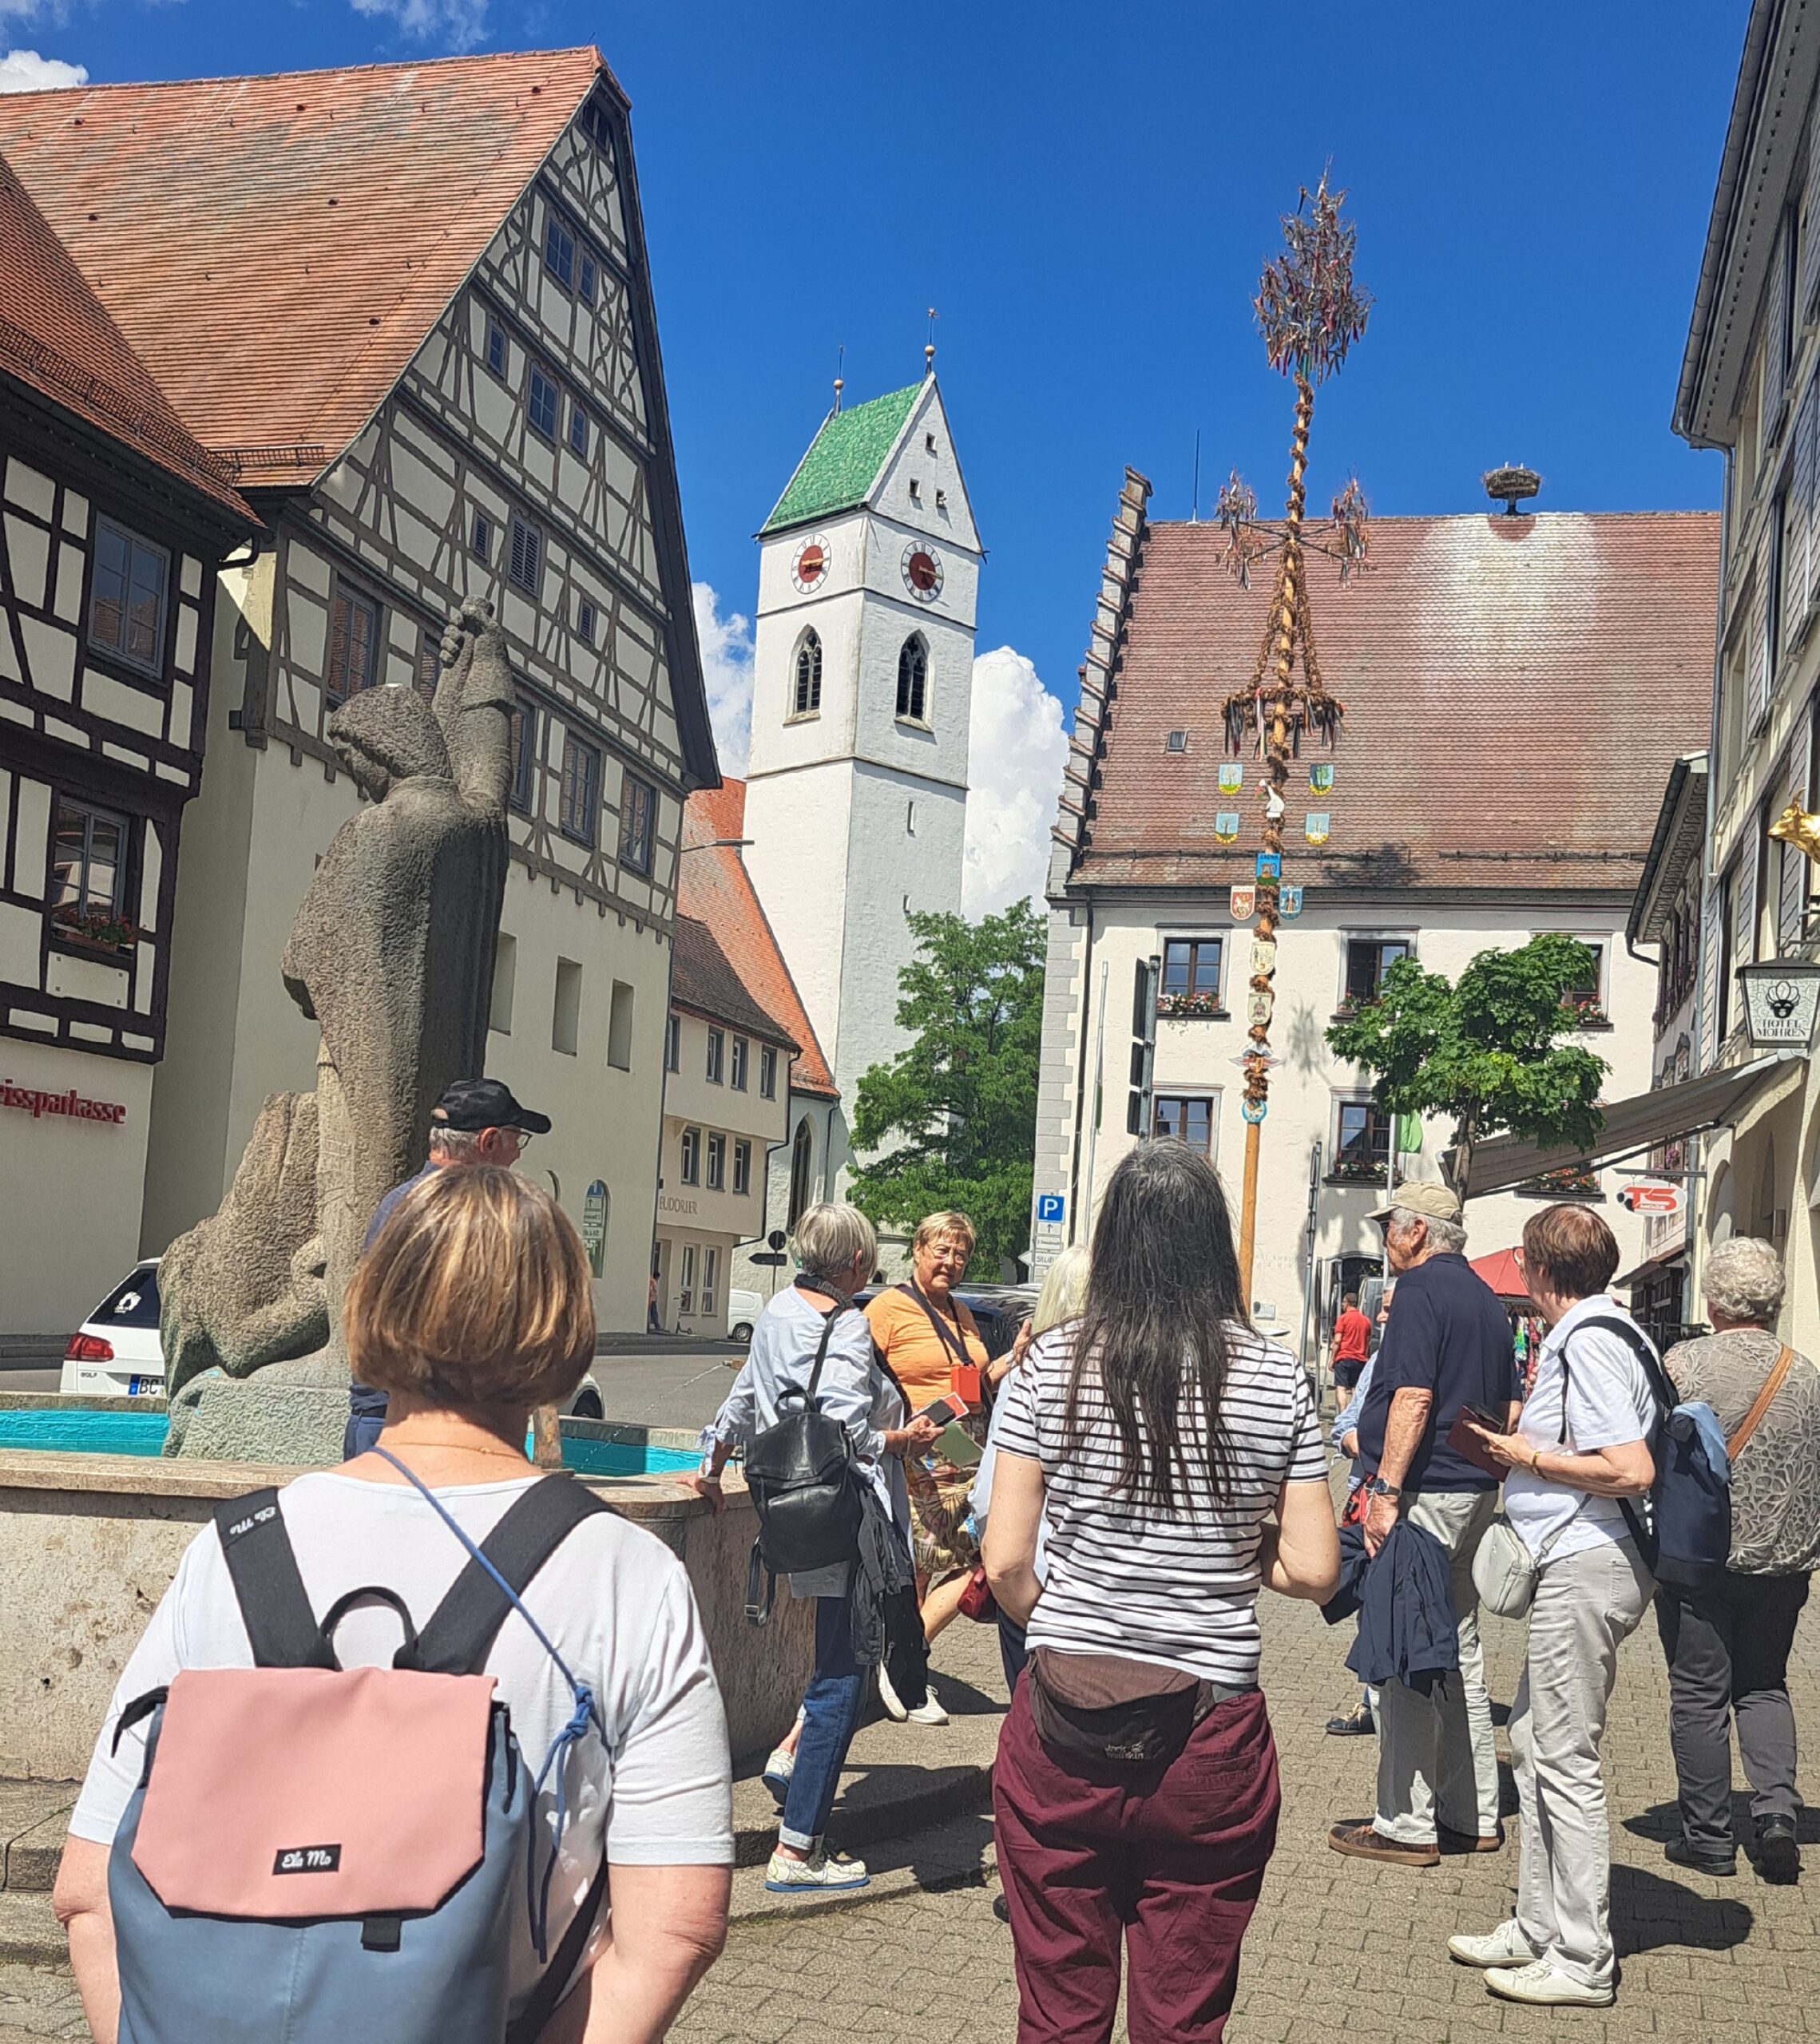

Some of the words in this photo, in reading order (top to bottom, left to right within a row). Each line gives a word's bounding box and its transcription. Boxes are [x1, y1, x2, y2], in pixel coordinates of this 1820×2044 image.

[1763, 1019, 1801, 1028] HOTEL
[1757, 1028, 1806, 1036] MOHREN
[1624, 1186, 1677, 1210] TS
[1044, 1198, 1058, 1218] P
